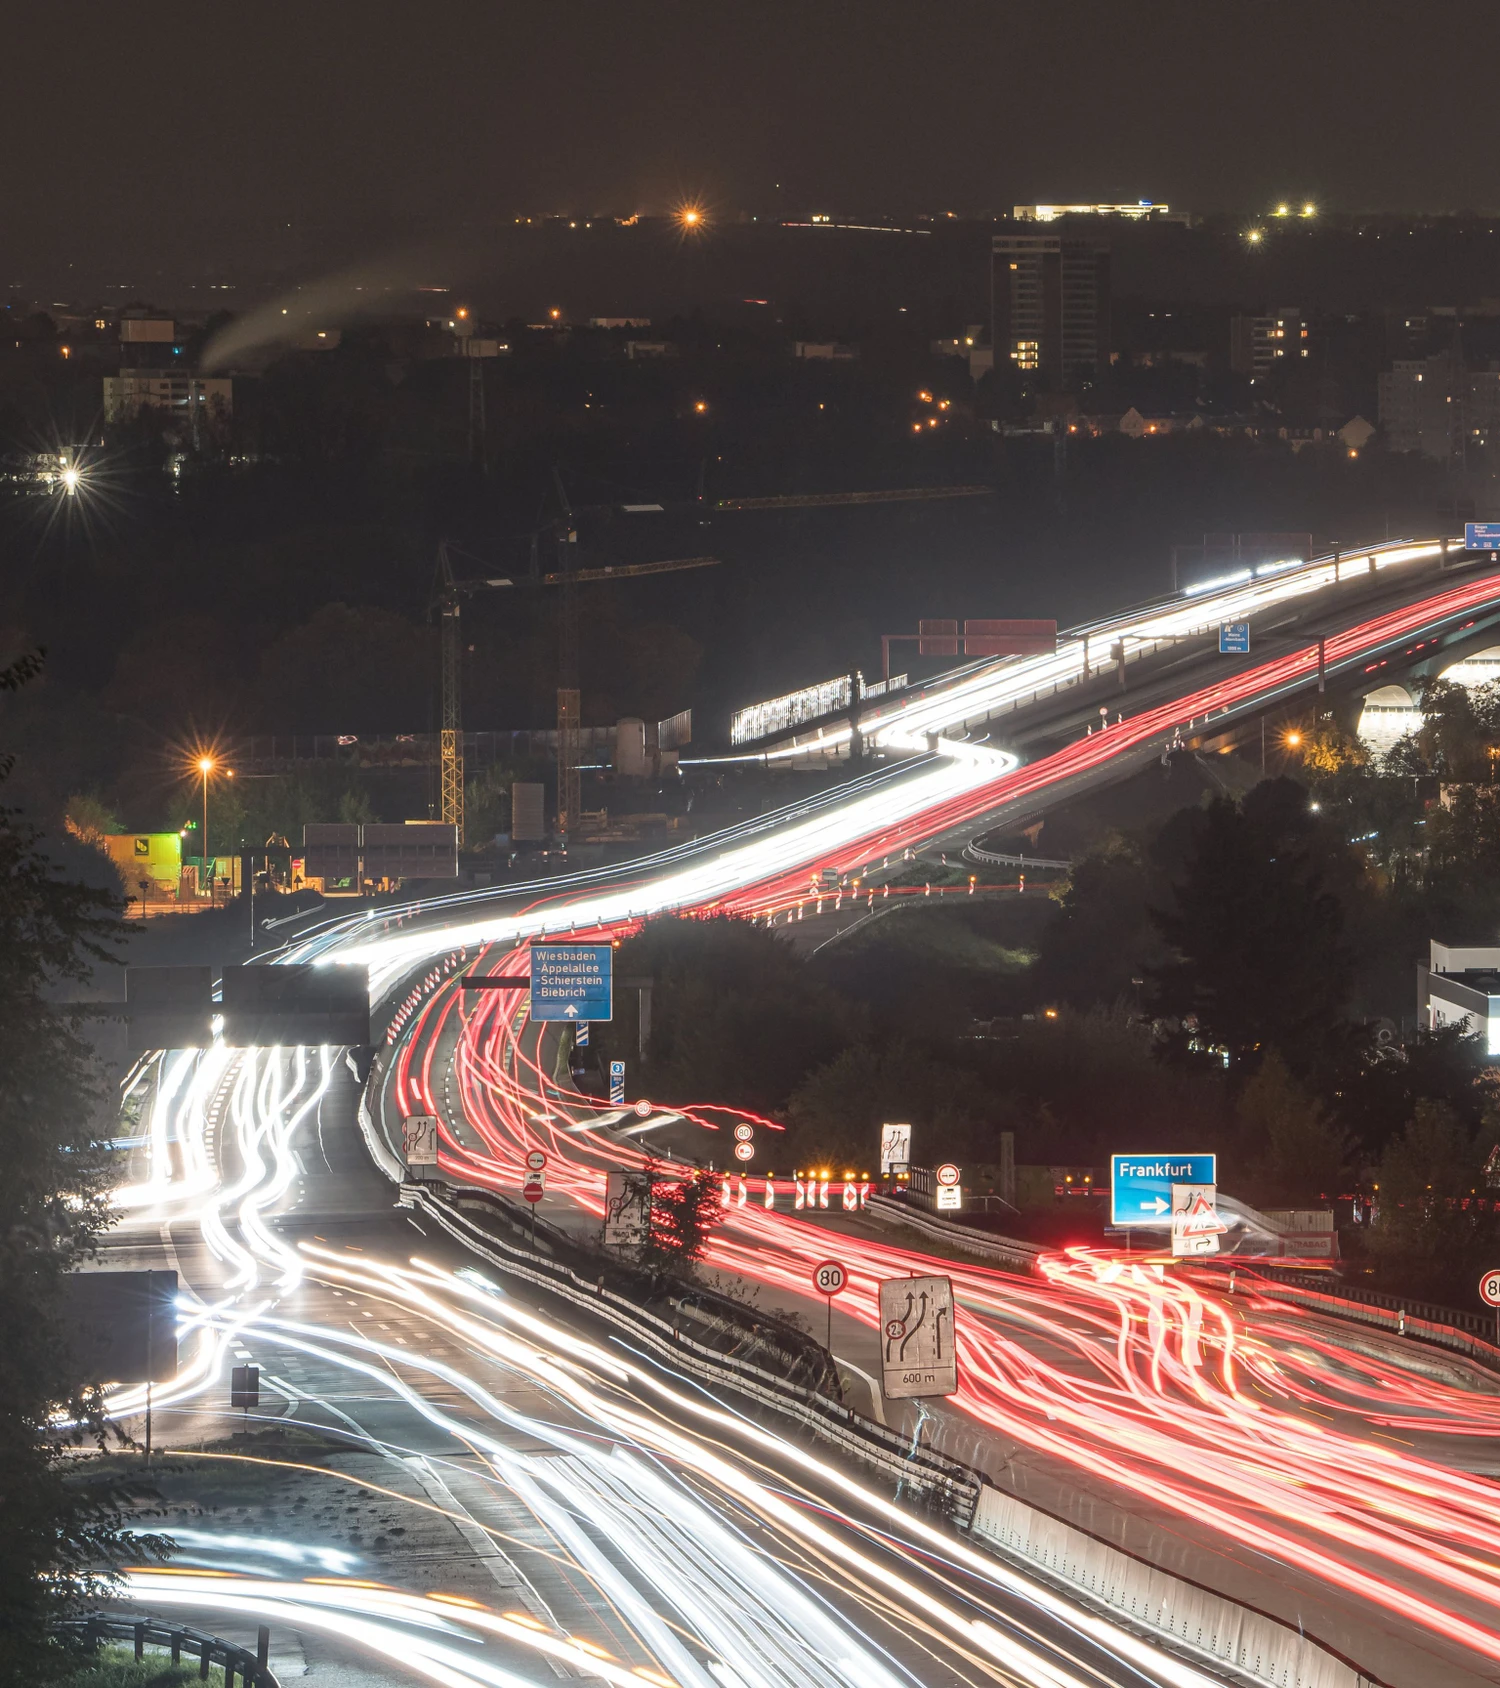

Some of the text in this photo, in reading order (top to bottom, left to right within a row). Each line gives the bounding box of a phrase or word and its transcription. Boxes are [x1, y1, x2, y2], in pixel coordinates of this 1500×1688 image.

[536, 951, 596, 961] Wiesbaden
[536, 961, 599, 974] -Äppelallee
[536, 975, 602, 985] -Schierstein
[536, 987, 586, 997] -Biebrich
[1119, 1162, 1193, 1177] Frankfurt
[820, 1270, 841, 1286] 80
[903, 1373, 935, 1383] 600 m
